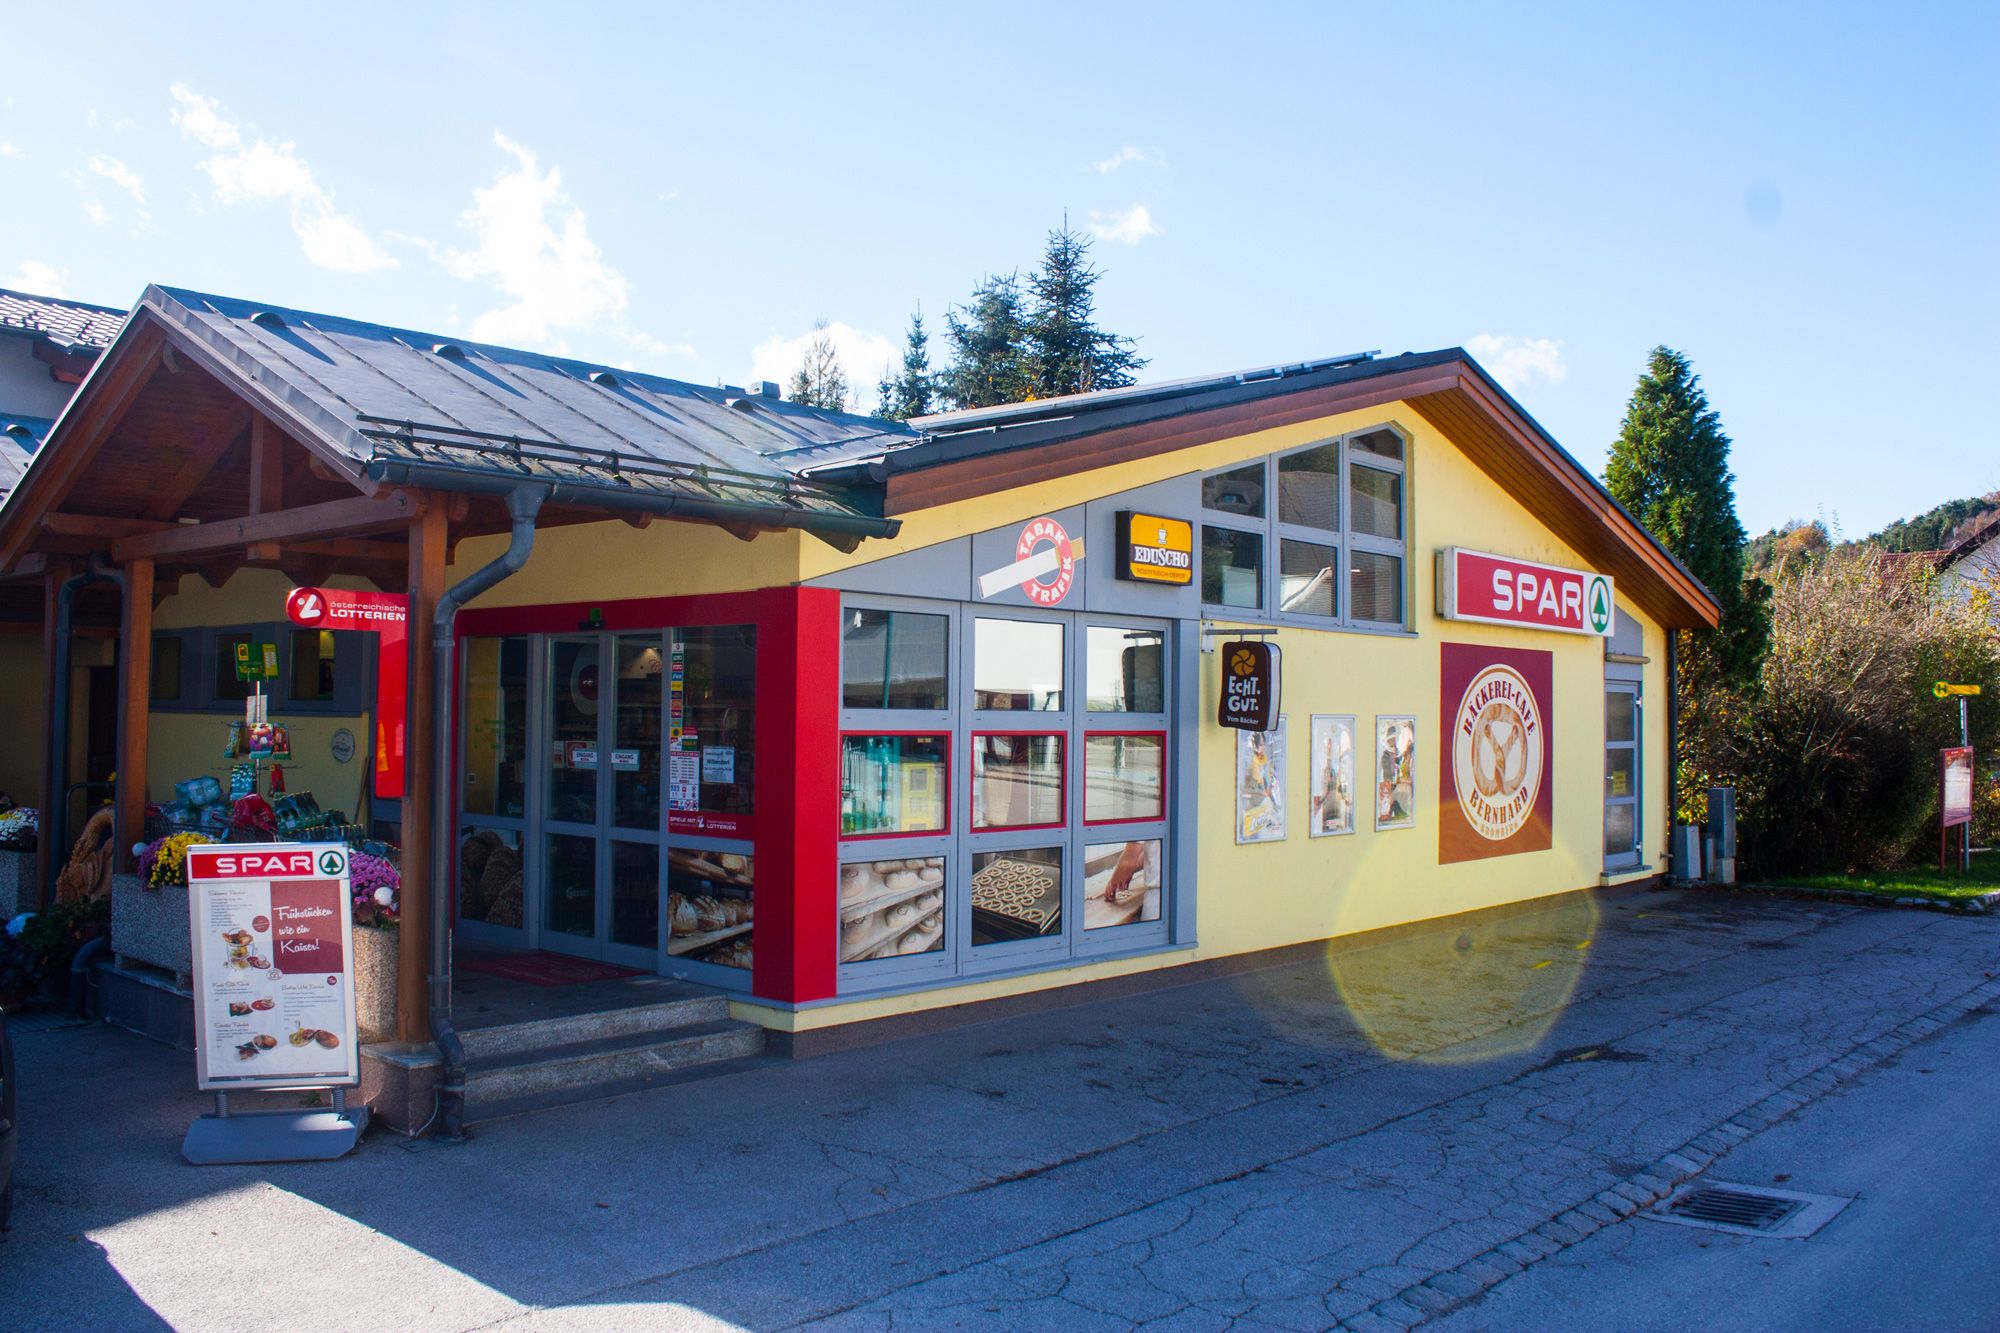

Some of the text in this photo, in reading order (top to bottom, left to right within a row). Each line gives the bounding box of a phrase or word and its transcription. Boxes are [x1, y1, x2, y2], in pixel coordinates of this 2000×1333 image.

[1019, 522, 1065, 555] TABAK
[1134, 546, 1189, 568] EDUSCHO
[1031, 556, 1072, 602] TRAFIK
[1492, 568, 1581, 621] SPAR
[329, 601, 406, 612] österreichische
[329, 609, 406, 621] LOTTERIEN
[1470, 785, 1529, 825] BERNHARD
[706, 823, 737, 831] LOTTERIEN
[215, 855, 312, 874] SPAR
[273, 905, 333, 921] Frühstücken
[279, 925, 295, 936] wie
[296, 924, 310, 935] ein
[280, 938, 320, 954] Kaiser!
